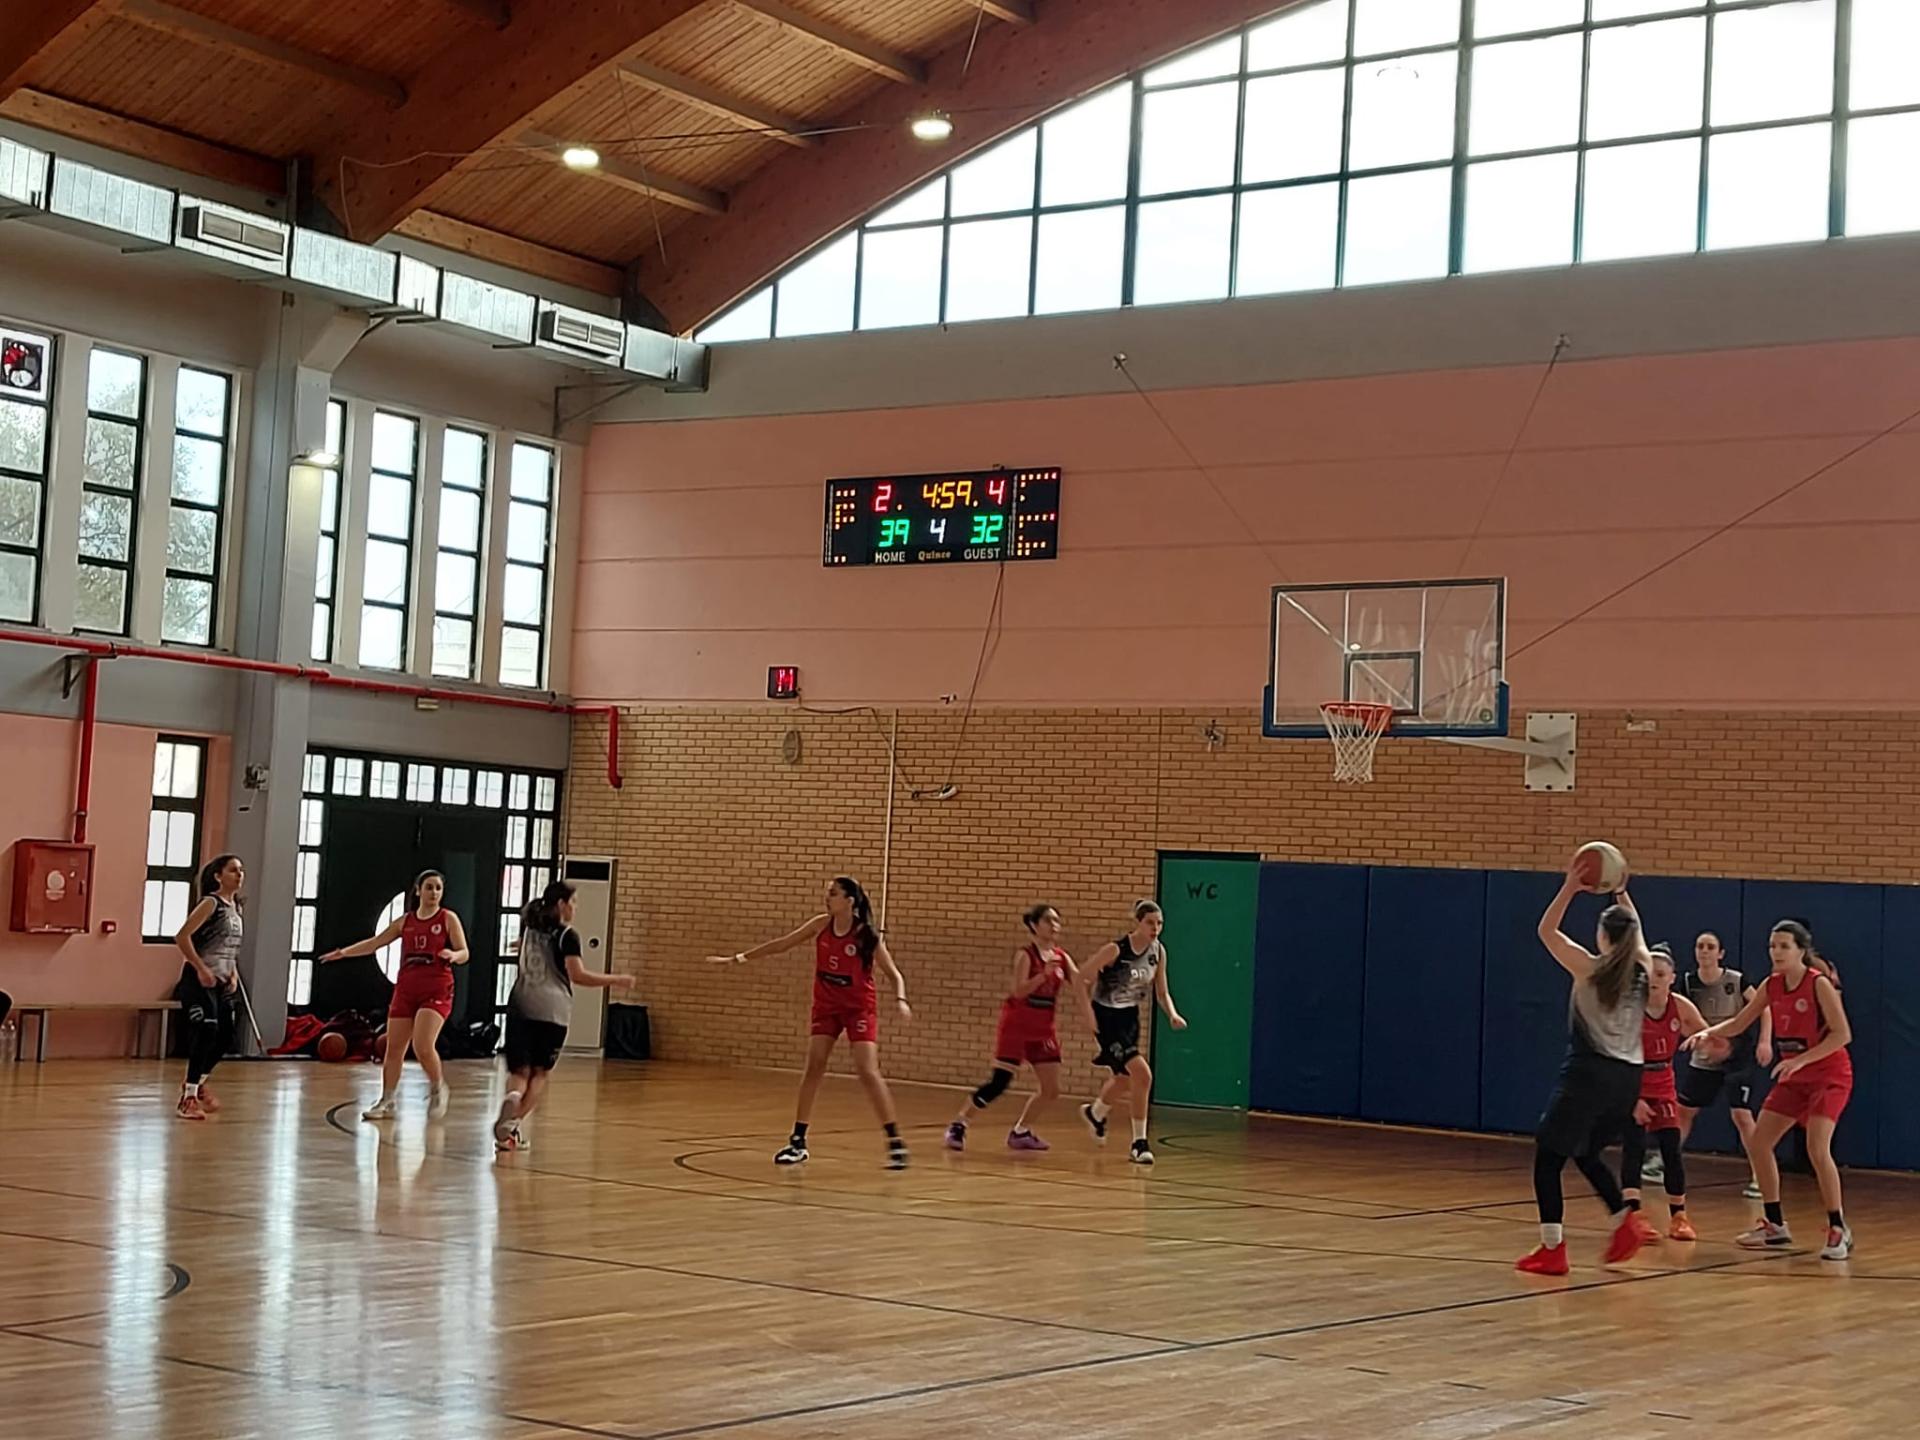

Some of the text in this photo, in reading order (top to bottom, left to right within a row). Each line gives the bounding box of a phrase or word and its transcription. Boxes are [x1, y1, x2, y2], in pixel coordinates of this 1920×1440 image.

[988, 480, 1005, 505] 4
[878, 518, 910, 548] 39
[930, 518, 946, 544] 4
[970, 515, 1004, 544] 32
[875, 551, 906, 563] HOME
[963, 547, 1001, 560] GUEST
[1186, 881, 1219, 900] WC
[828, 955, 839, 970] 5
[856, 1020, 868, 1033] 5
[1781, 1014, 1791, 1031] 7
[1655, 1037, 1668, 1055] 11
[1740, 1085, 1750, 1103] 7
